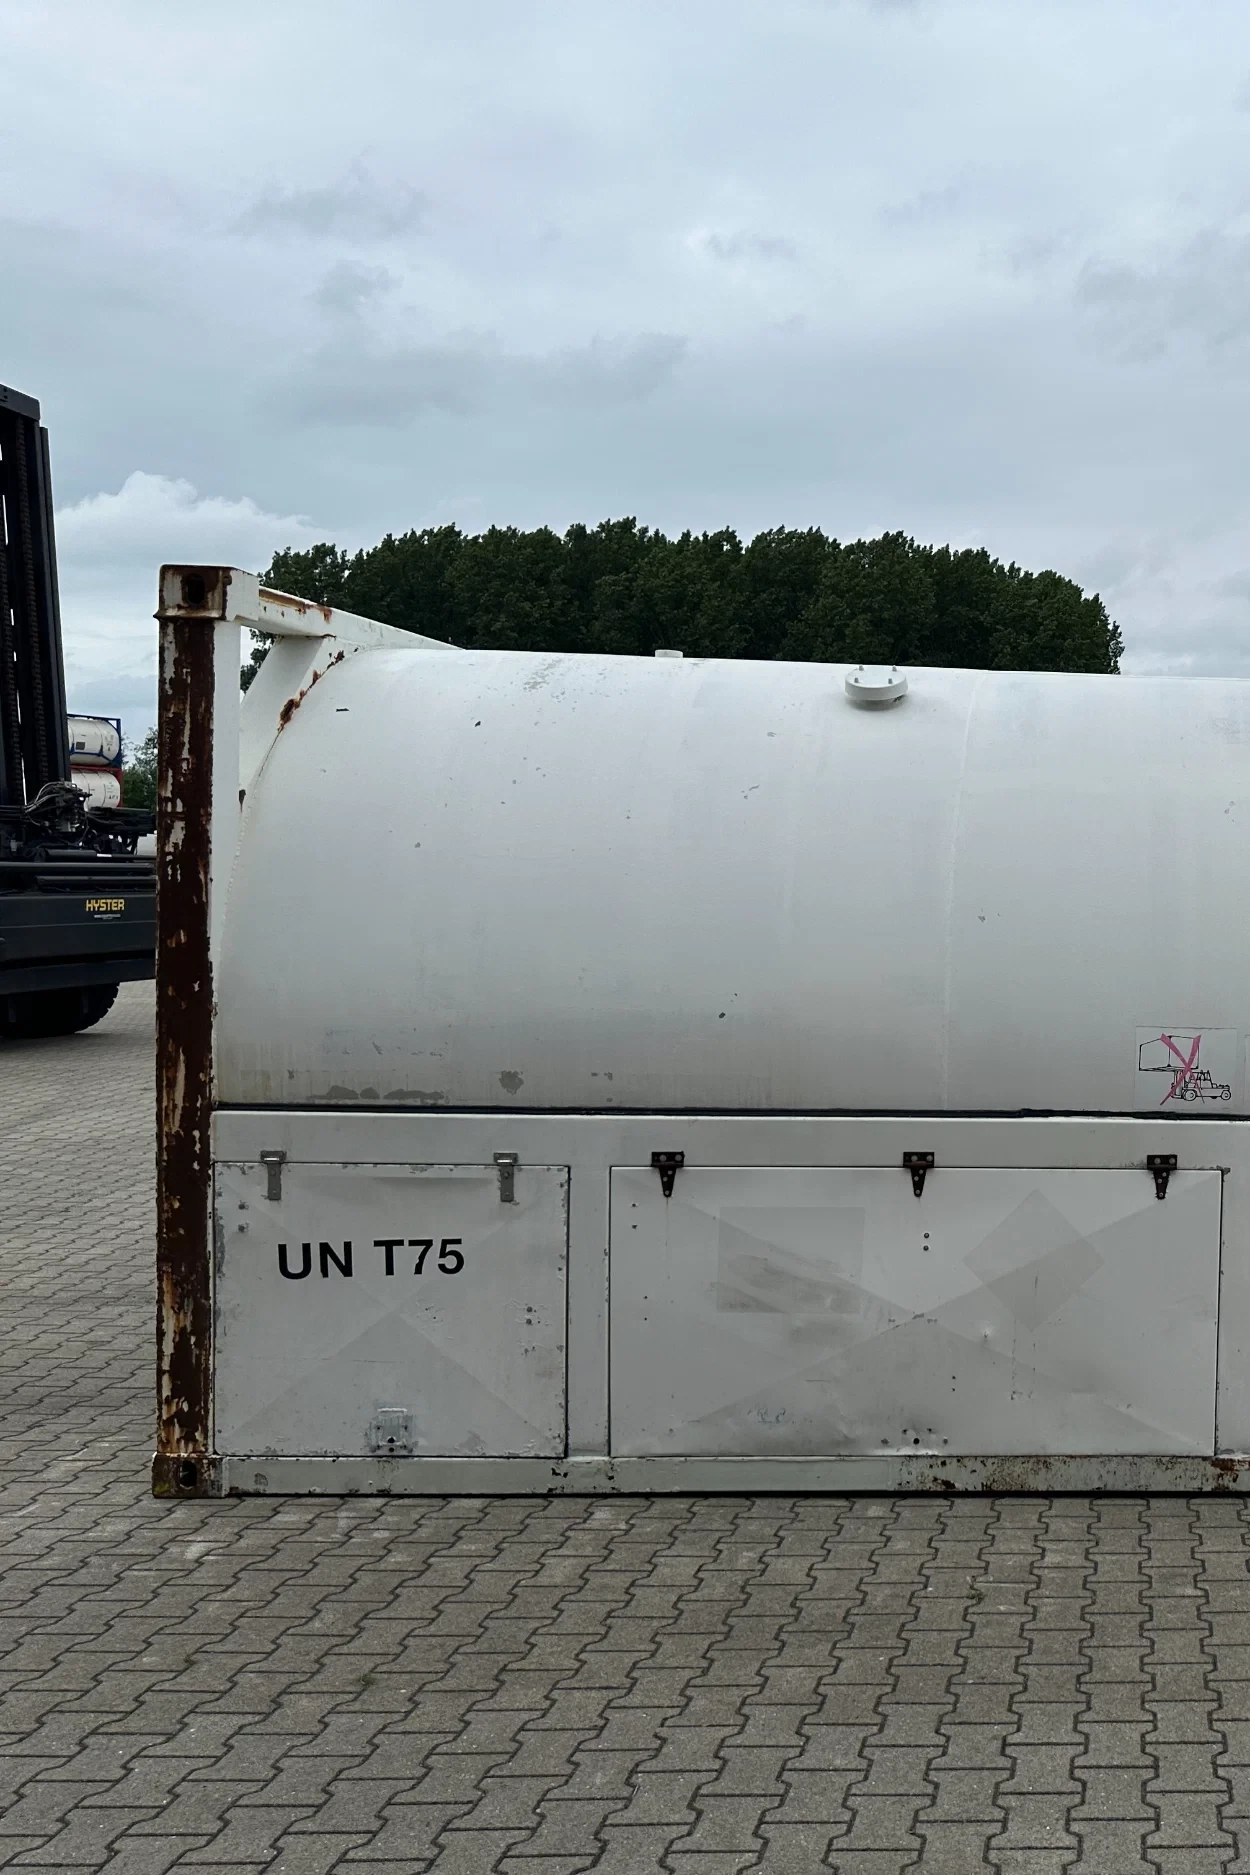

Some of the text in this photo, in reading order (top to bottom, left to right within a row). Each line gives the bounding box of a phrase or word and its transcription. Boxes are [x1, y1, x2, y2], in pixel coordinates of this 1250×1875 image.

[85, 898, 126, 912] HYSTER
[277, 1238, 465, 1280] UN T75
